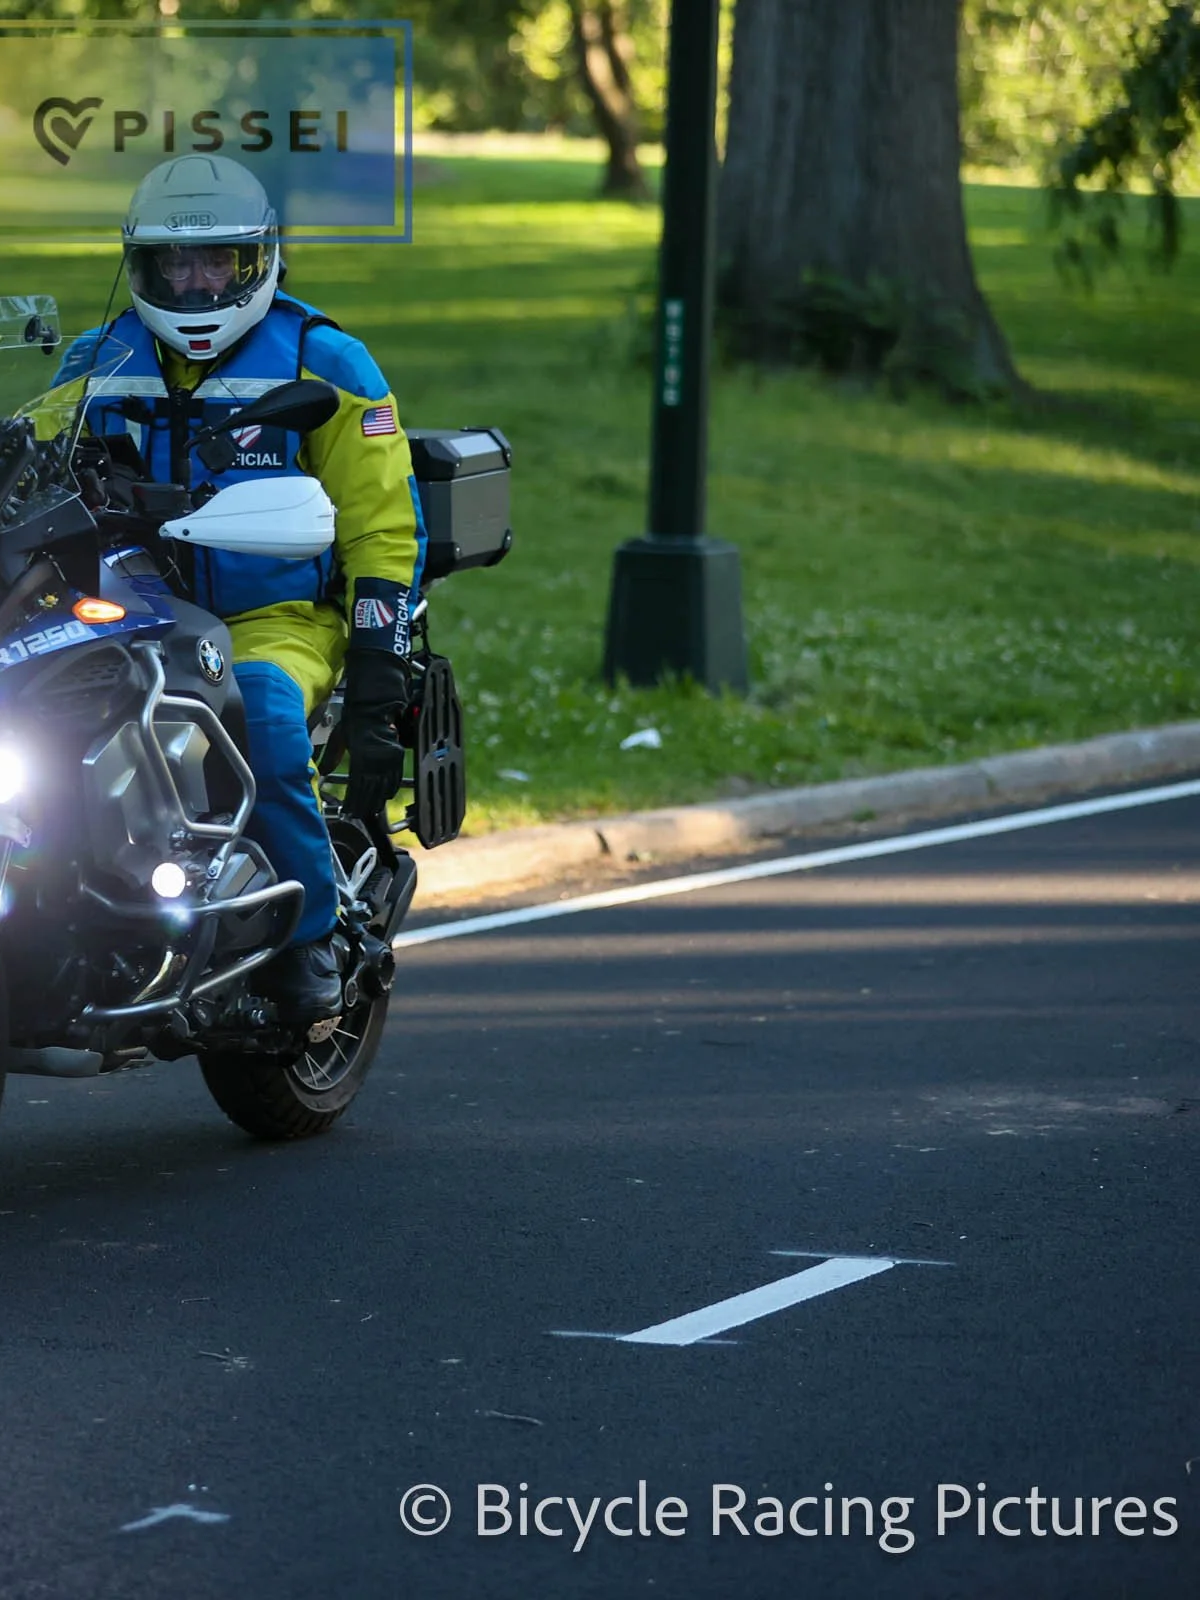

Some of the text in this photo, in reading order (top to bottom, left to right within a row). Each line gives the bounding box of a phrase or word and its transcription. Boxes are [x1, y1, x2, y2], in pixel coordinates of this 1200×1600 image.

[171, 214, 210, 228] SHOEI
[232, 453, 283, 466] ICIAL
[356, 601, 367, 627] USA
[393, 589, 410, 655] OFFICIAL
